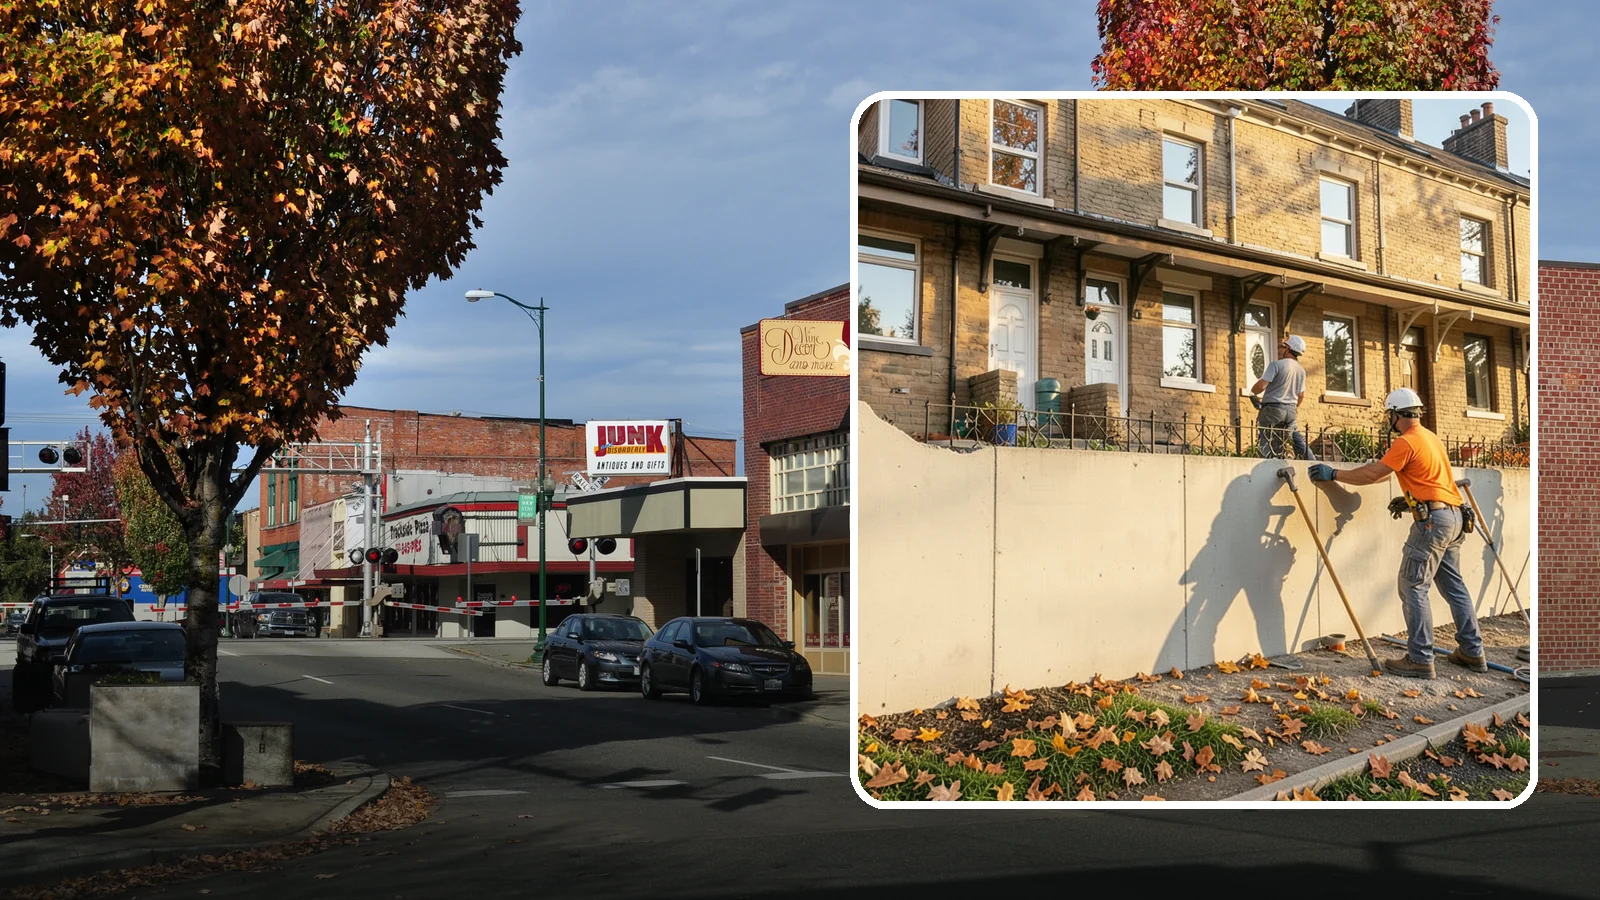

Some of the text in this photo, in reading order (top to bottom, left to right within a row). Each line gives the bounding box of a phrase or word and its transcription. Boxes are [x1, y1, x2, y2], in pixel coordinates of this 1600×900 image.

[595, 425, 665, 457] JUNK
[607, 446, 645, 454] DISORDERLY
[597, 460, 666, 470] ANTIQUES AND GIFTS
[573, 473, 588, 490] RAIL
[586, 476, 608, 492] SING
[352, 498, 365, 511] CRO
[414, 519, 429, 535] Pizza
